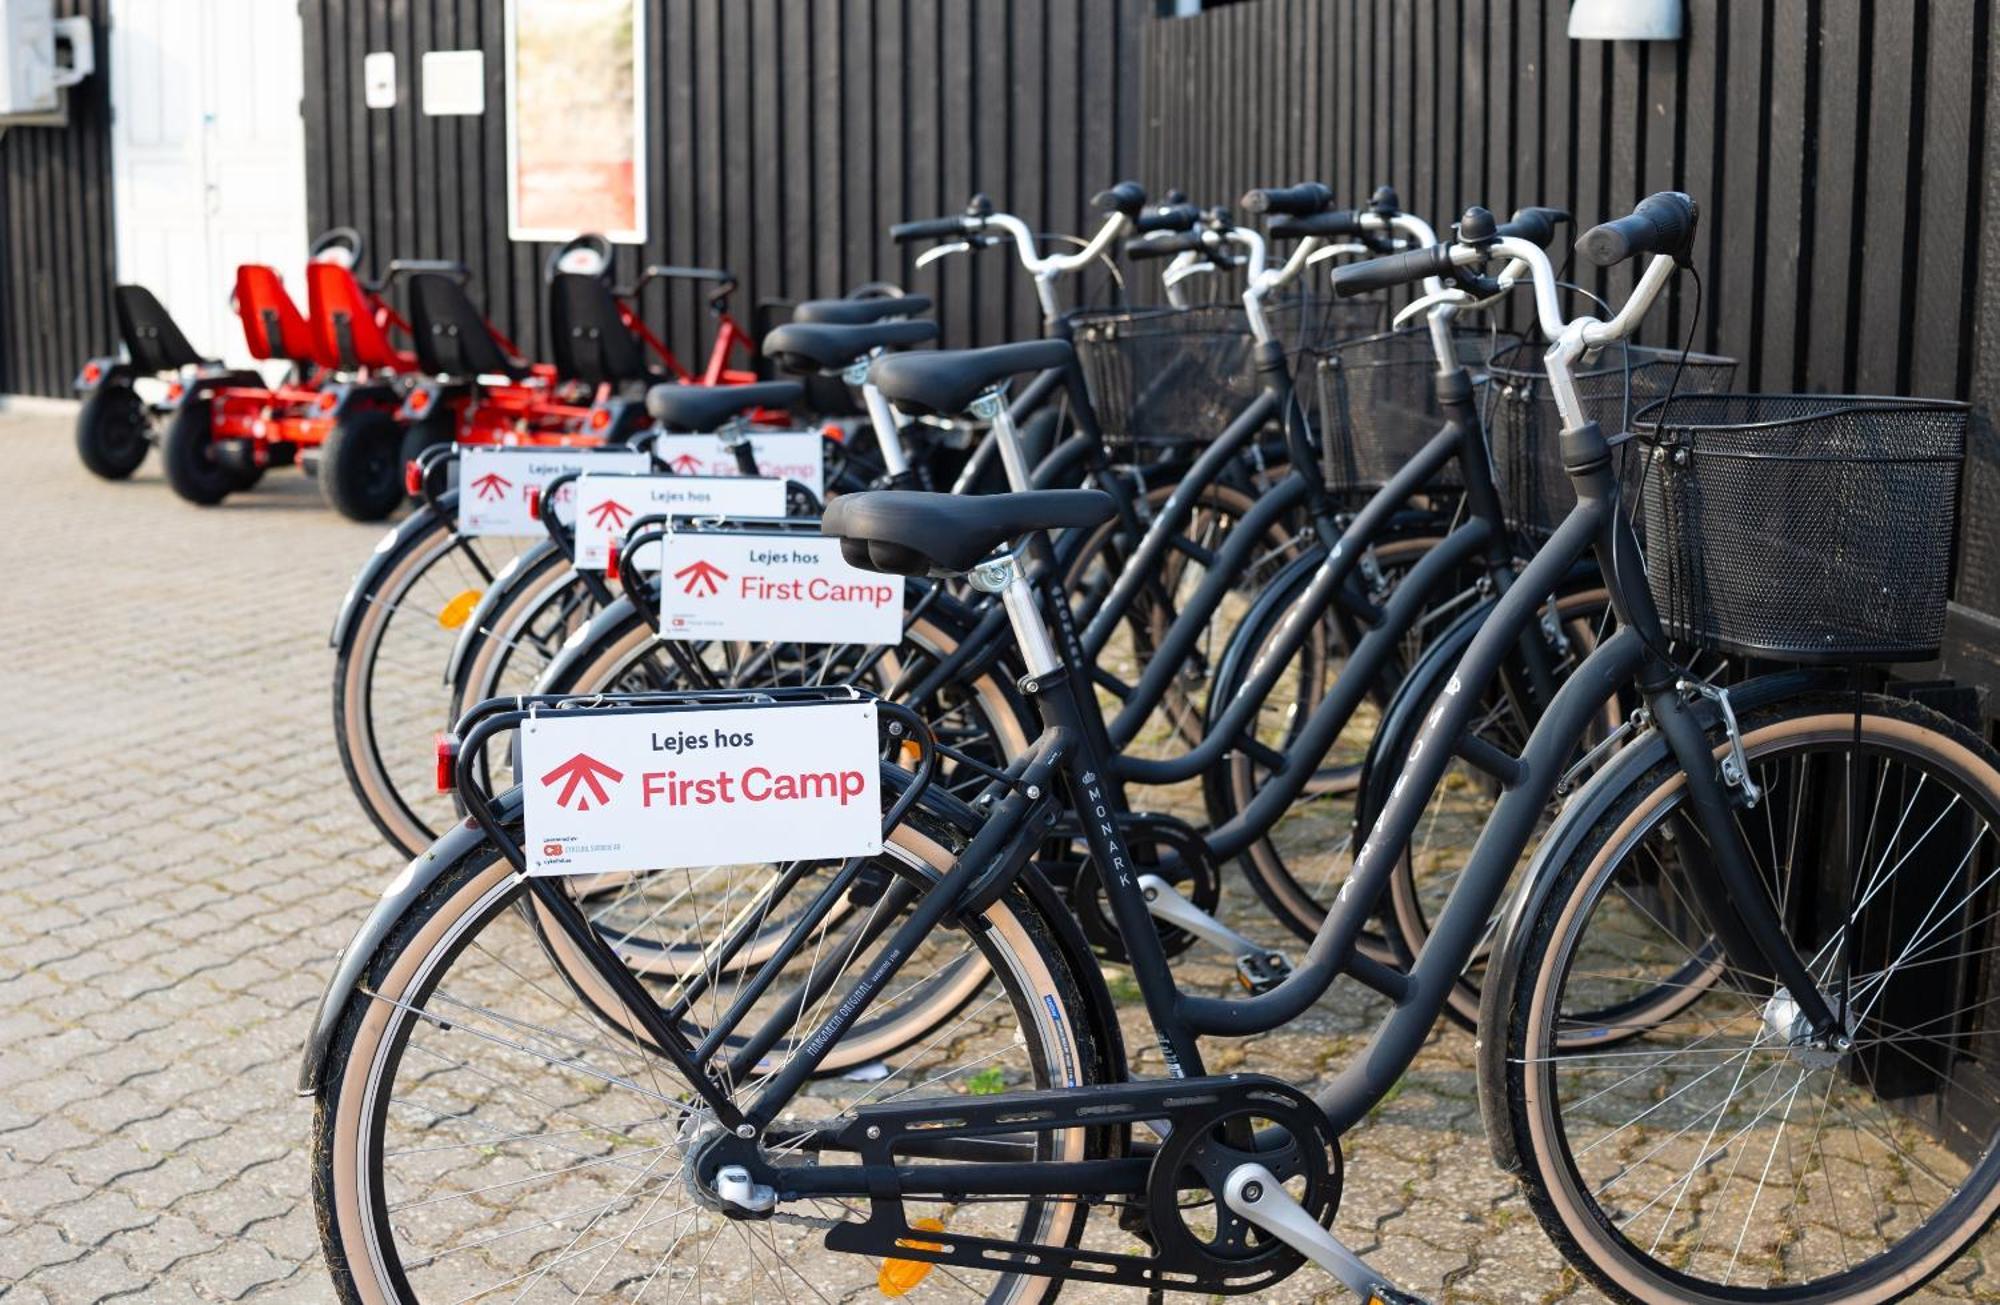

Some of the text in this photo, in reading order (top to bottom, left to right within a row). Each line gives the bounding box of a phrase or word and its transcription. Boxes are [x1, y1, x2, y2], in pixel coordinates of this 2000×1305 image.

[528, 464, 559, 475] Lejes
[651, 490, 711, 503] Lejes hos
[750, 550, 819, 566] Lejes hos
[741, 577, 893, 608] First Camp
[651, 729, 754, 755] Lejes hos
[642, 766, 866, 808] First Camp
[1088, 786, 1131, 887] MONARK
[839, 981, 872, 1017] ORIGINAL
